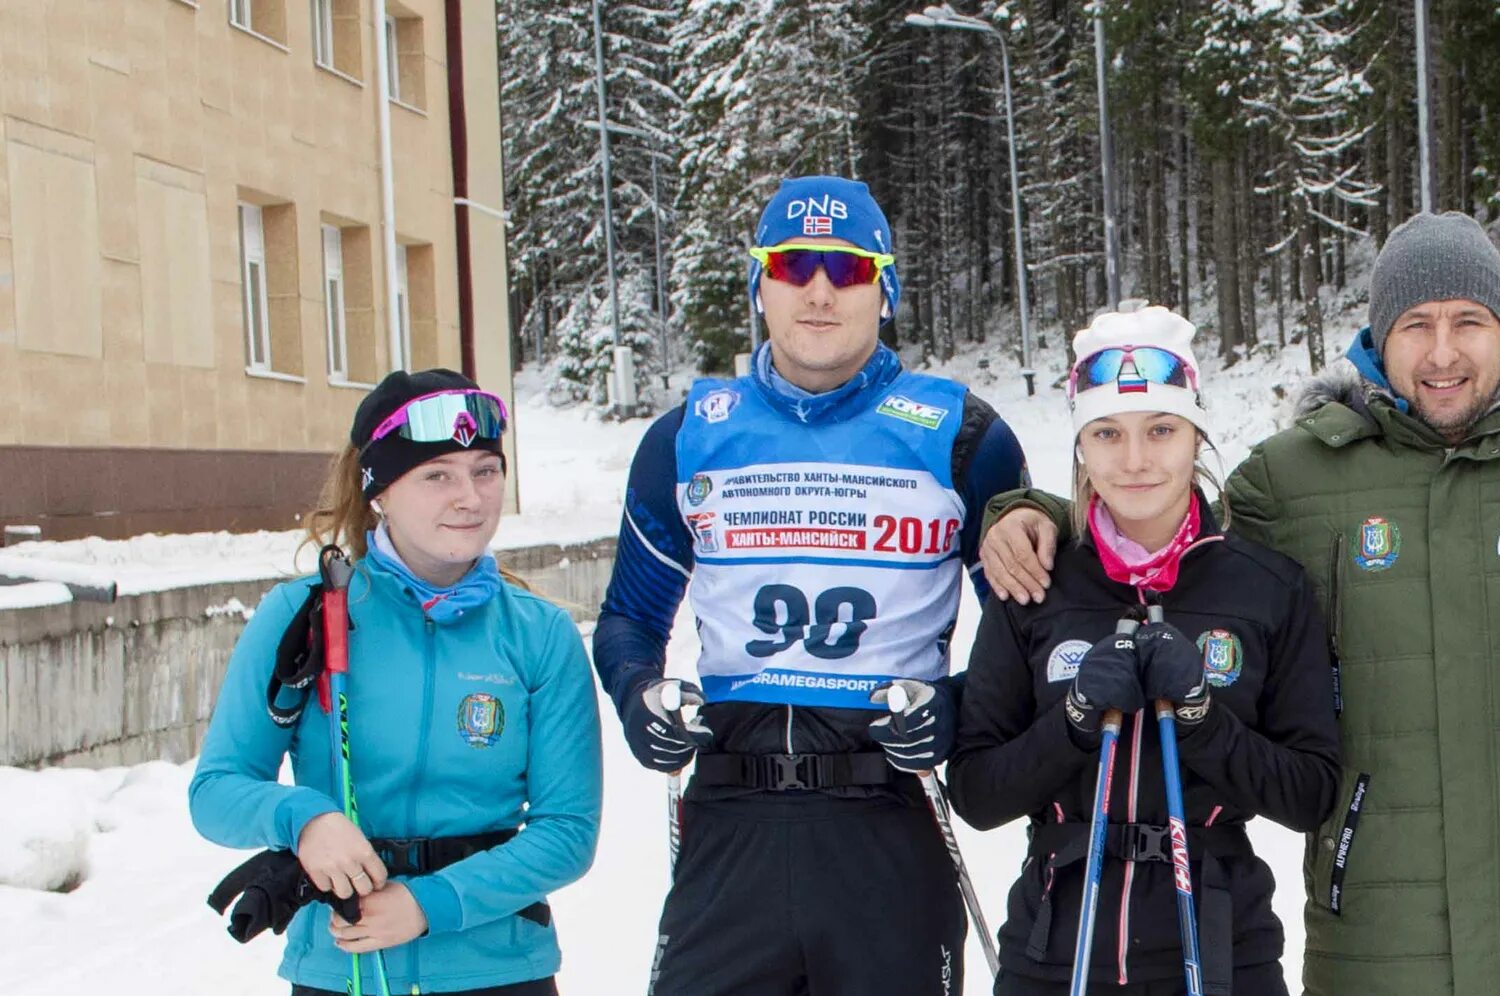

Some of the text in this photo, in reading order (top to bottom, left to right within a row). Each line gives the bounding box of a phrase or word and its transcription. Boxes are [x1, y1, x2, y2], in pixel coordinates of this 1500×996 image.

[787, 194, 848, 219] DNB
[804, 473, 917, 489] ХАНТЫ-МАНСИЙСКОГО
[722, 486, 867, 499] АВТОНОМНОГО ОКРУГА-ЮГРЫ
[723, 510, 804, 526] ЧЕМПИОНАТ
[809, 511, 866, 527] РОССИИ
[732, 530, 858, 548] ХАНТЫ-МАНСИЙСК
[745, 584, 877, 659] 90
